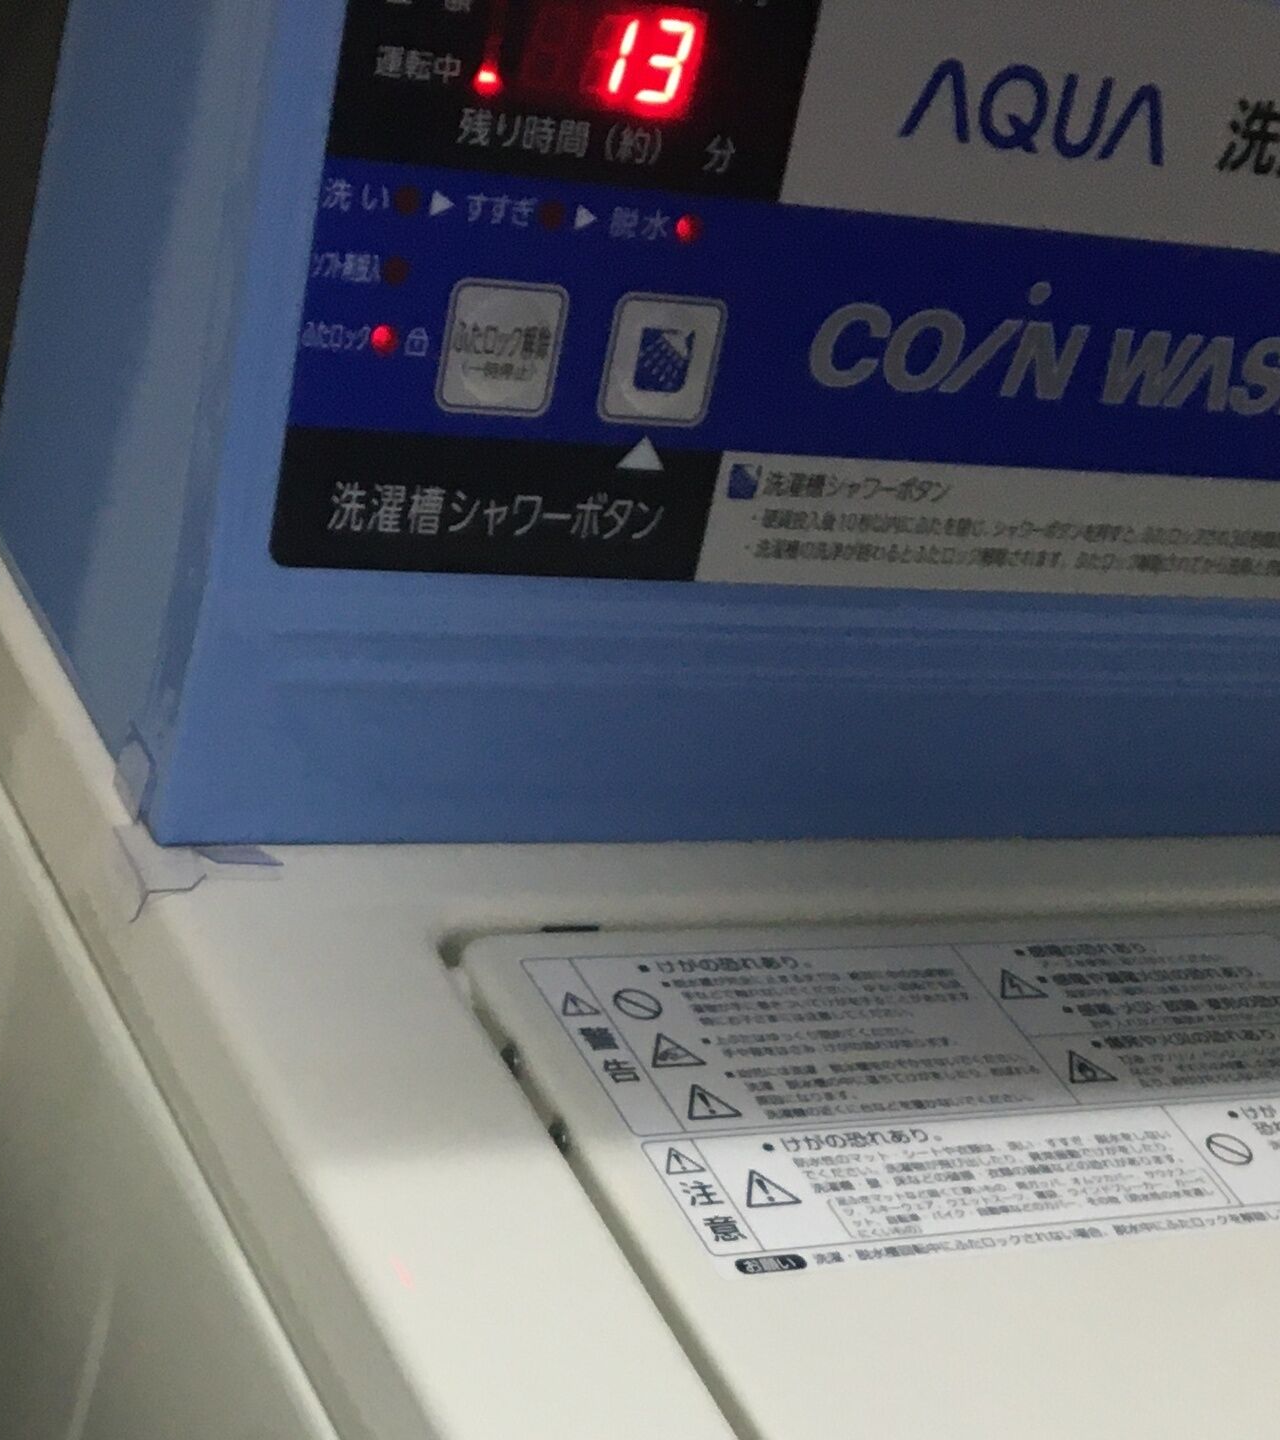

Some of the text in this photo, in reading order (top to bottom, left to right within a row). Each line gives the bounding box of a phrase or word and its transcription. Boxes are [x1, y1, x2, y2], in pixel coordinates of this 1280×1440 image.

[375, 44, 462, 84] 運転中
[609, 19, 696, 103] 13
[898, 57, 1166, 167] AQUA
[466, 192, 536, 228] すすぎ
[609, 206, 670, 240] 脱水
[808, 281, 1090, 402] COIN
[327, 480, 664, 540] 洗濯槽シャワーボタン
[681, 1180, 747, 1242] 注意
